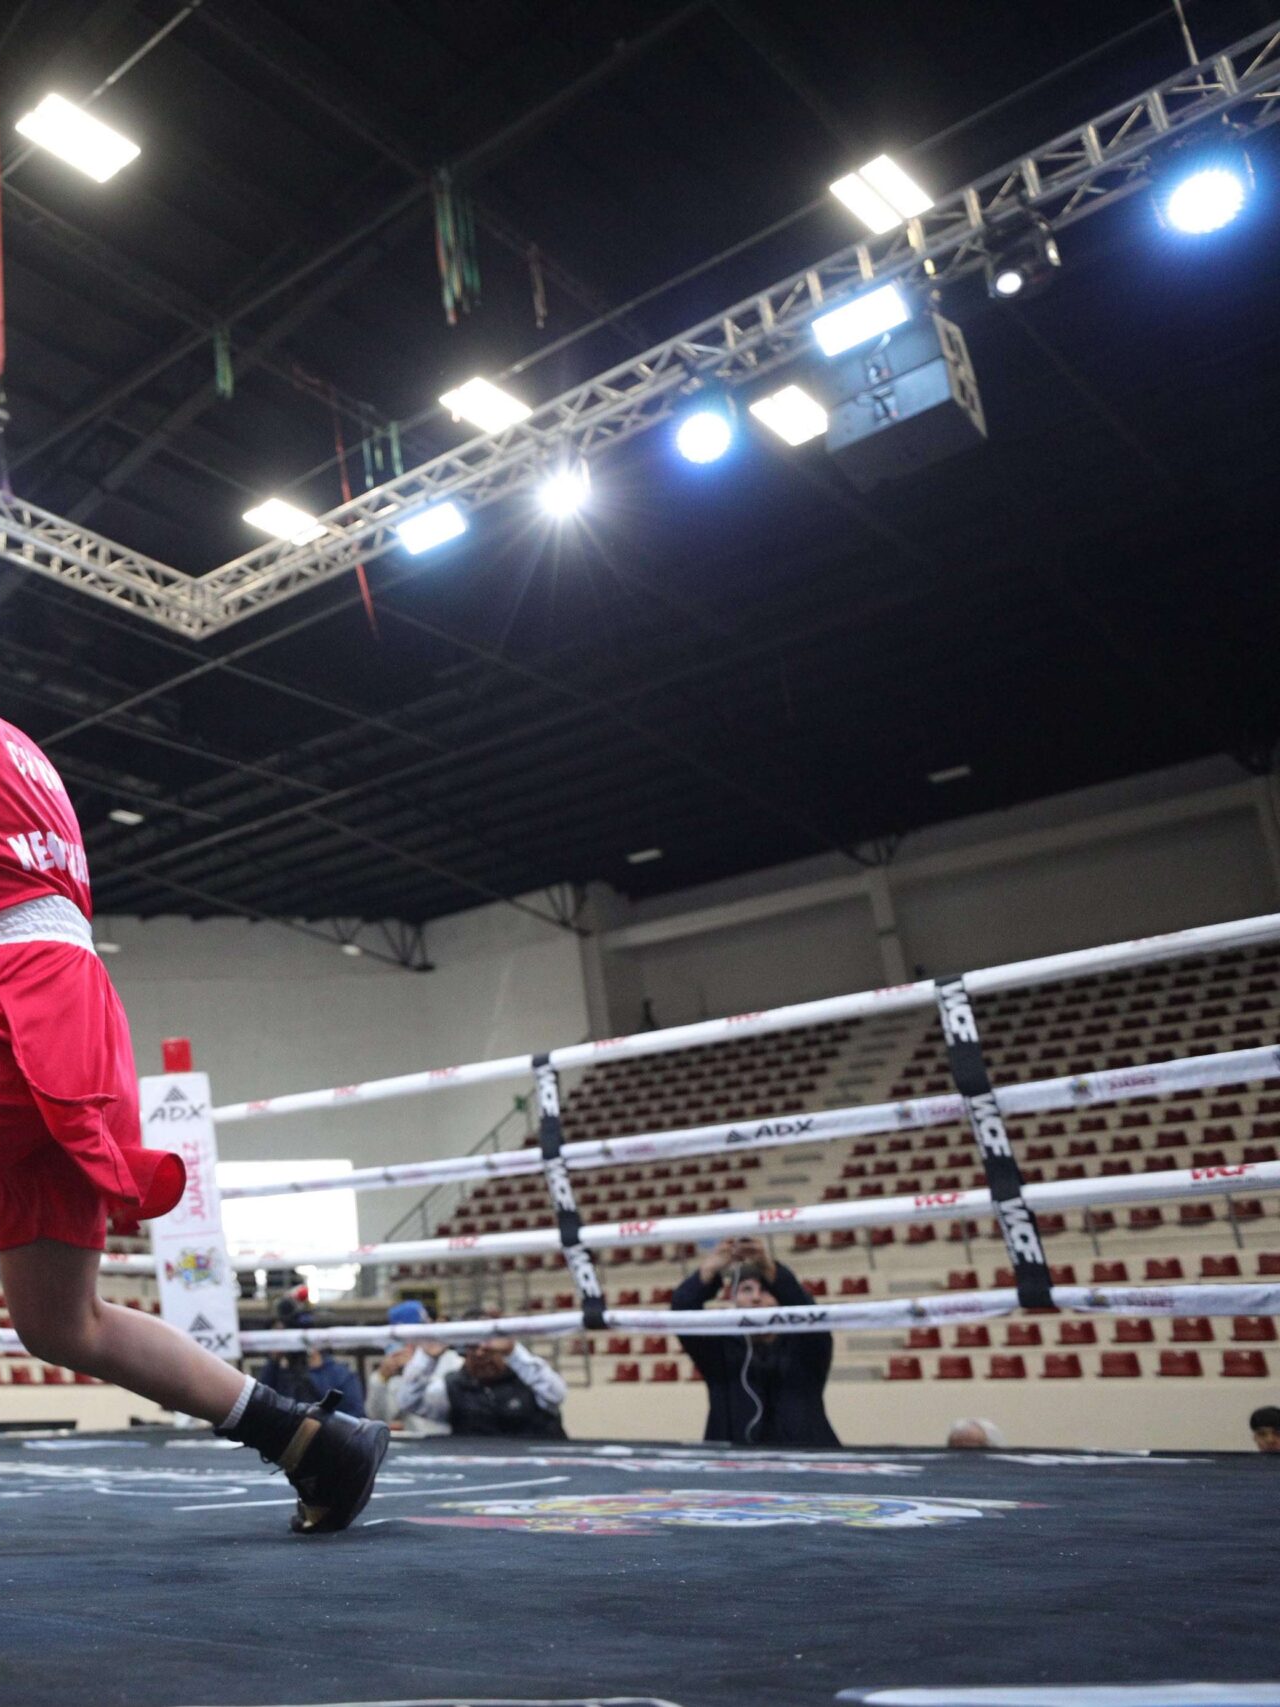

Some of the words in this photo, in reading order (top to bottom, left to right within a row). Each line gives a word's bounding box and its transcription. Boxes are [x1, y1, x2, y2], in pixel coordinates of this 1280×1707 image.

[942, 979, 980, 1043] WCF
[148, 1103, 205, 1123] ADX
[756, 1119, 813, 1138] ADX
[971, 1092, 1012, 1157] WCF
[999, 1199, 1044, 1265] WCF
[768, 1311, 827, 1325] ADX
[194, 1334, 233, 1353] DX
